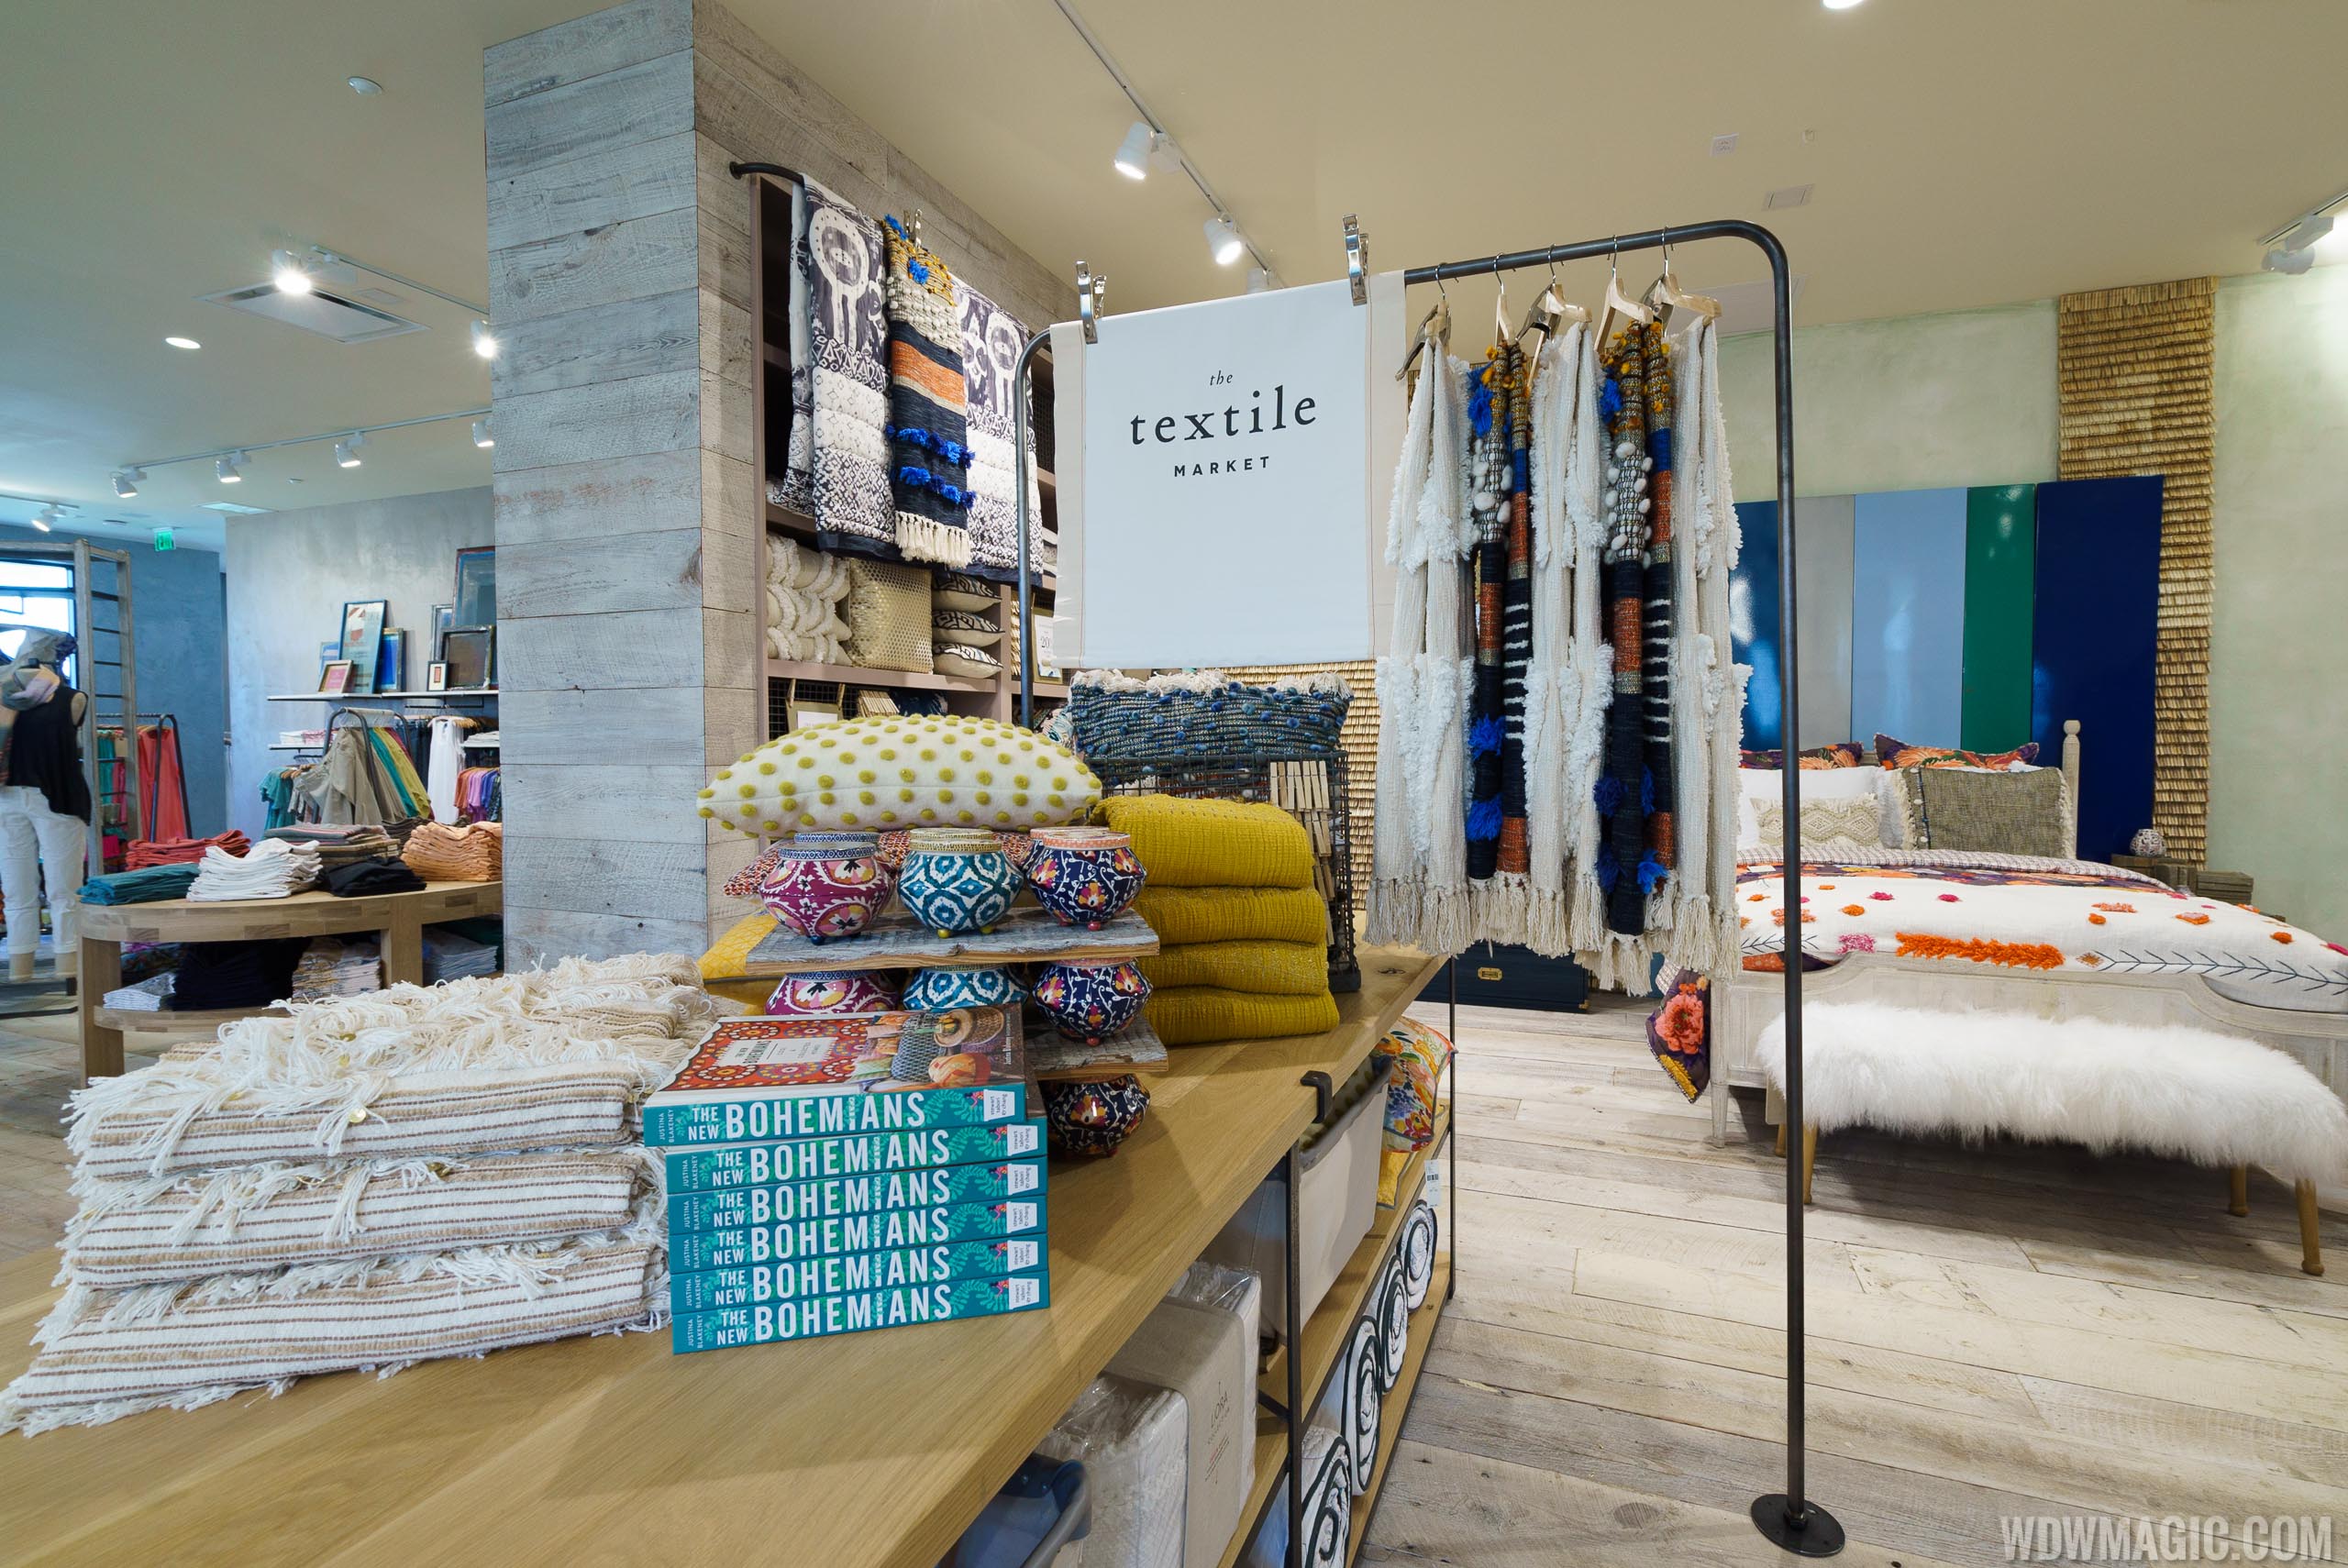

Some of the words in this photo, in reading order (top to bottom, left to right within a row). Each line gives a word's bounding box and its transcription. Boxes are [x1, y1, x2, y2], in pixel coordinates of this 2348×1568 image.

[1210, 370, 1234, 386] the
[1130, 385, 1316, 446] textile
[1174, 456, 1269, 477] MARKET
[692, 1106, 719, 1122] THE
[725, 1091, 925, 1139] BOHEMIANS
[688, 1124, 719, 1141] NEW
[715, 1152, 743, 1168] THE
[750, 1130, 950, 1183] BOHEMIANS
[712, 1168, 744, 1187] NEW
[717, 1192, 744, 1209] THE
[751, 1169, 950, 1223] BOHEMIANS
[714, 1210, 745, 1227] NEW
[717, 1231, 744, 1247] THE
[751, 1207, 949, 1262] BOHEMIANS
[714, 1248, 745, 1265] NEW
[719, 1270, 746, 1287] THE
[752, 1246, 951, 1302] BOHEMIANS
[715, 1287, 747, 1306] NEW
[721, 1309, 748, 1327] THE
[754, 1285, 952, 1341] BOHEMIANS
[717, 1328, 748, 1346] NEW
